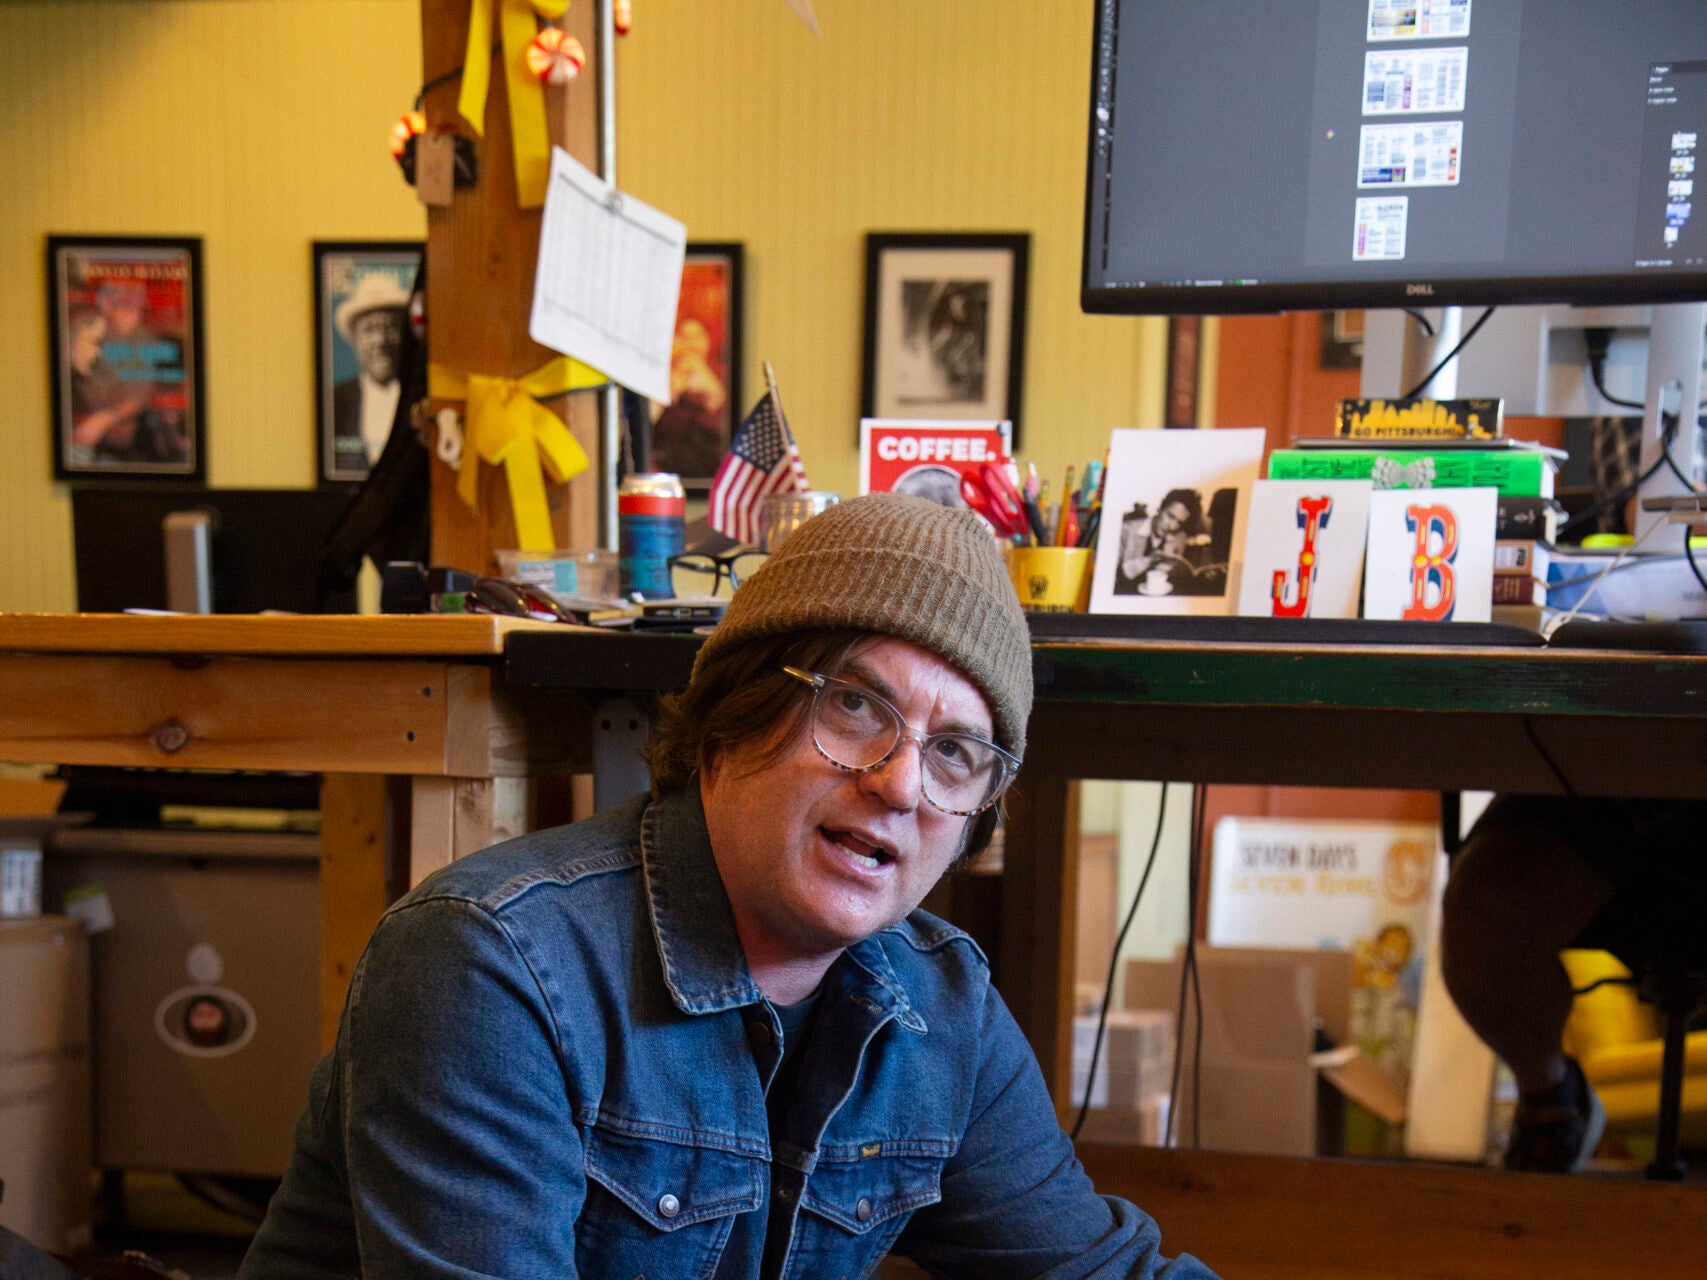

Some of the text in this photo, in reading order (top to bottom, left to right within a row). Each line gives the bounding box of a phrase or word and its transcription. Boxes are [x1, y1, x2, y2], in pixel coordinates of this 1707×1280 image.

[1406, 283, 1435, 296] DELL
[1354, 426, 1372, 437] GO
[878, 436, 997, 461] COFFEE.
[1272, 496, 1332, 618] J
[1402, 504, 1458, 621] B
